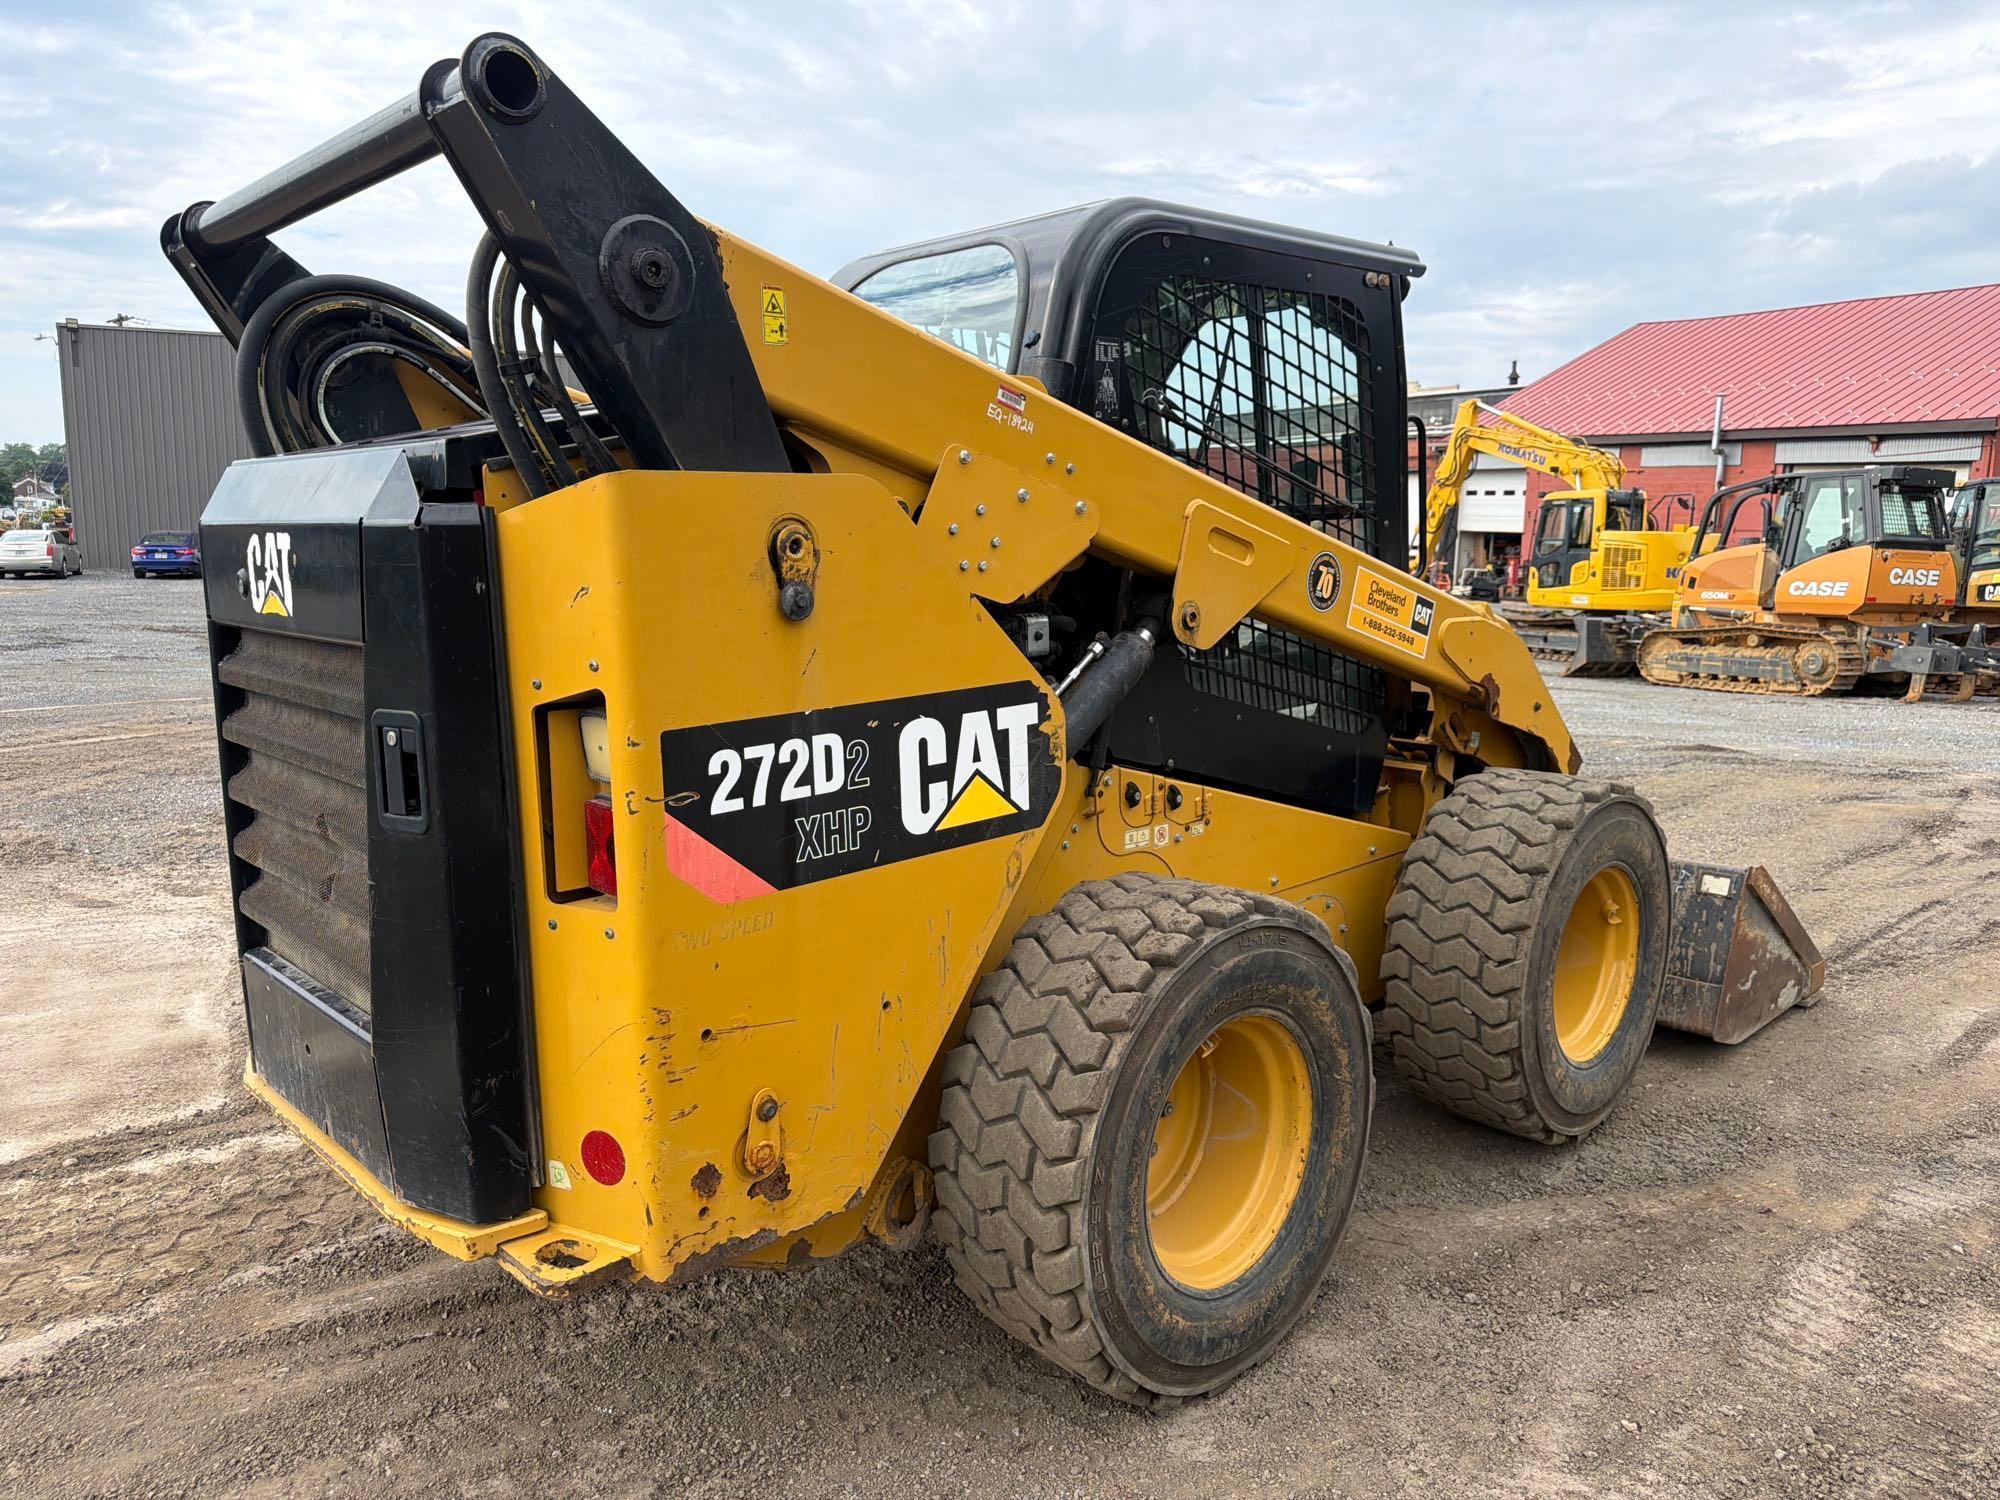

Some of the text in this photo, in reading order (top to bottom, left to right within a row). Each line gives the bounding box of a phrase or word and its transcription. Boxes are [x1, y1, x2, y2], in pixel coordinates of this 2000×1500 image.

[1497, 443, 1546, 465] KOMATSU
[246, 532, 293, 617] CAT
[1889, 568, 1941, 586] CASE
[1369, 580, 1407, 607] Cleveland
[1788, 581, 1849, 597] CASE
[1367, 593, 1399, 616] Brothers
[1414, 604, 1432, 626] CAT
[1362, 617, 1415, 646] 1-888-232-5948
[899, 702, 1039, 836] CAT
[794, 805, 872, 863] XHP
